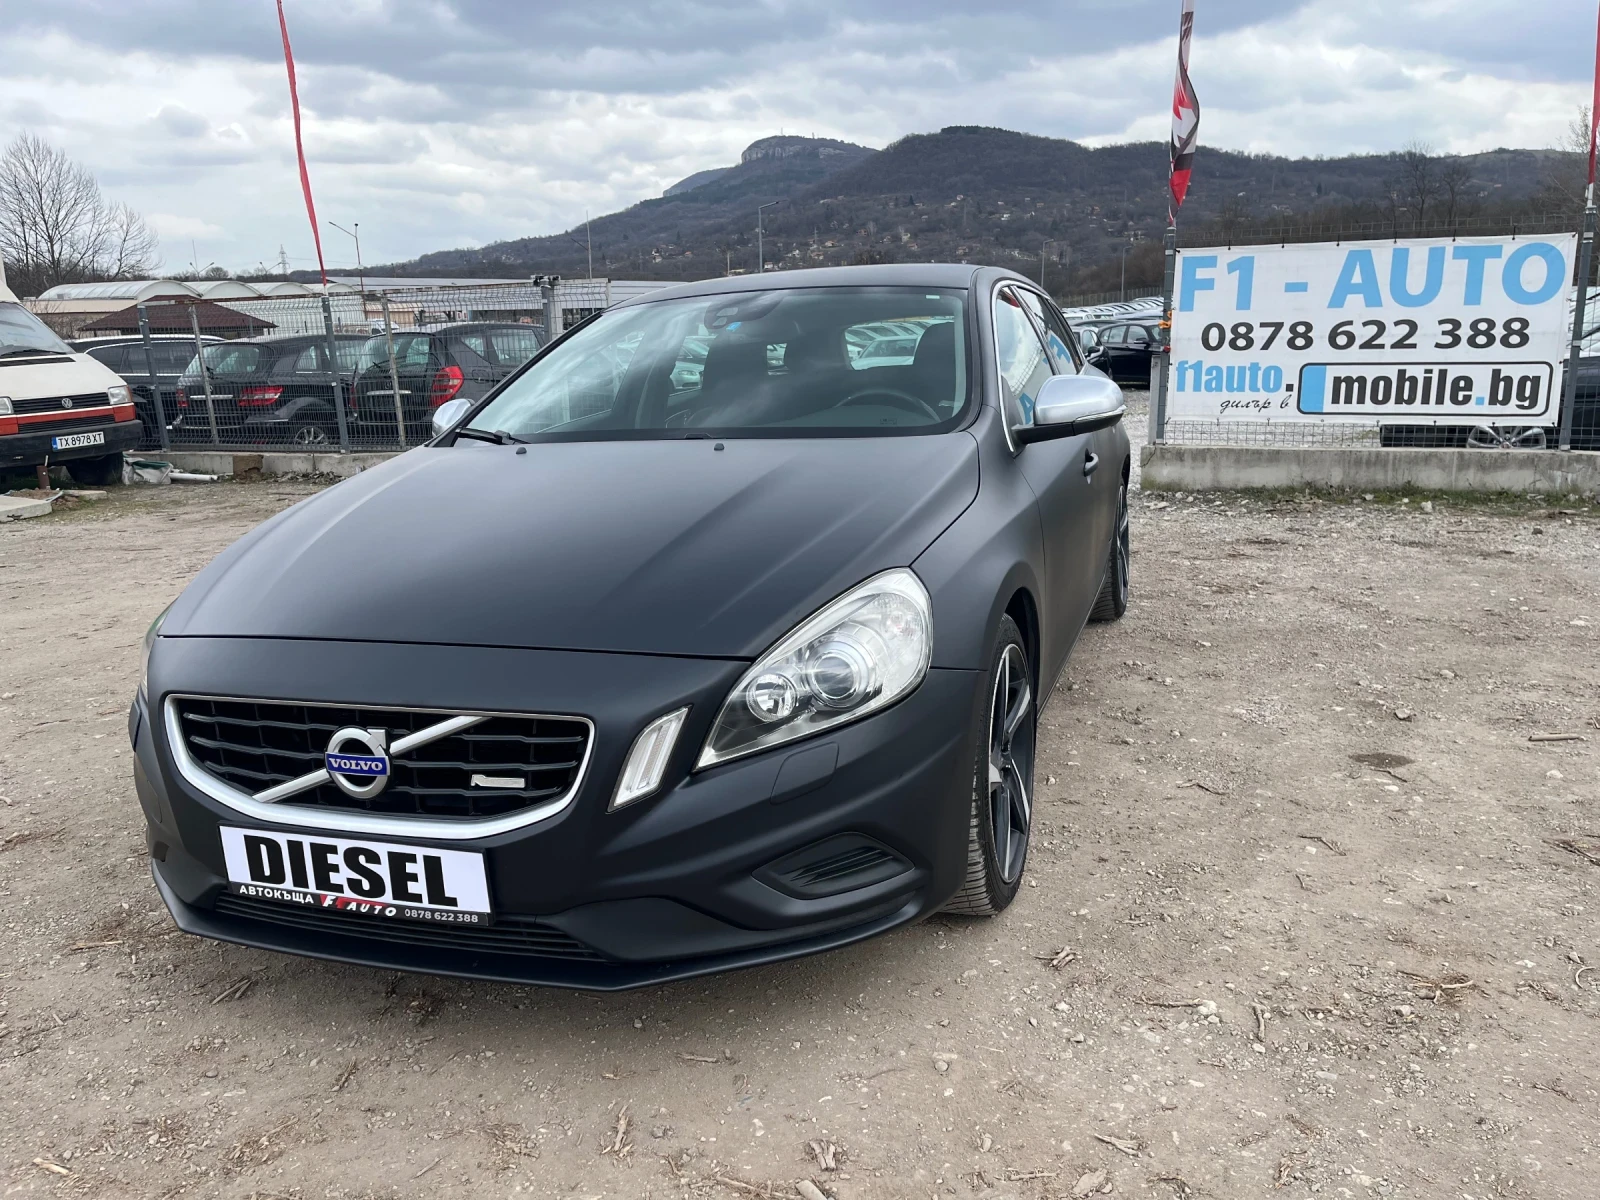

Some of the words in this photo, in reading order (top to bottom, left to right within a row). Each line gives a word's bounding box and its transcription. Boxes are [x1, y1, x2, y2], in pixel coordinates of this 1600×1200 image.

[1178, 255, 1255, 312] F1
[1327, 243, 1566, 309] AUTO
[1201, 321, 1314, 352] 0878
[1328, 319, 1418, 351] 622
[1434, 317, 1531, 350] 388
[1330, 368, 1542, 410] mobile.bg
[1220, 398, 1271, 414] дилър
[58, 437, 70, 448] TX
[71, 434, 91, 446] 8978
[92, 433, 102, 443] XT
[328, 757, 383, 771] VOLVO
[243, 834, 459, 907] DIESEL
[239, 885, 315, 905] АВТОКЪЩА
[346, 901, 397, 917] AUTO
[404, 908, 432, 919] 0878
[433, 911, 455, 921] 622
[456, 913, 479, 923] 388
